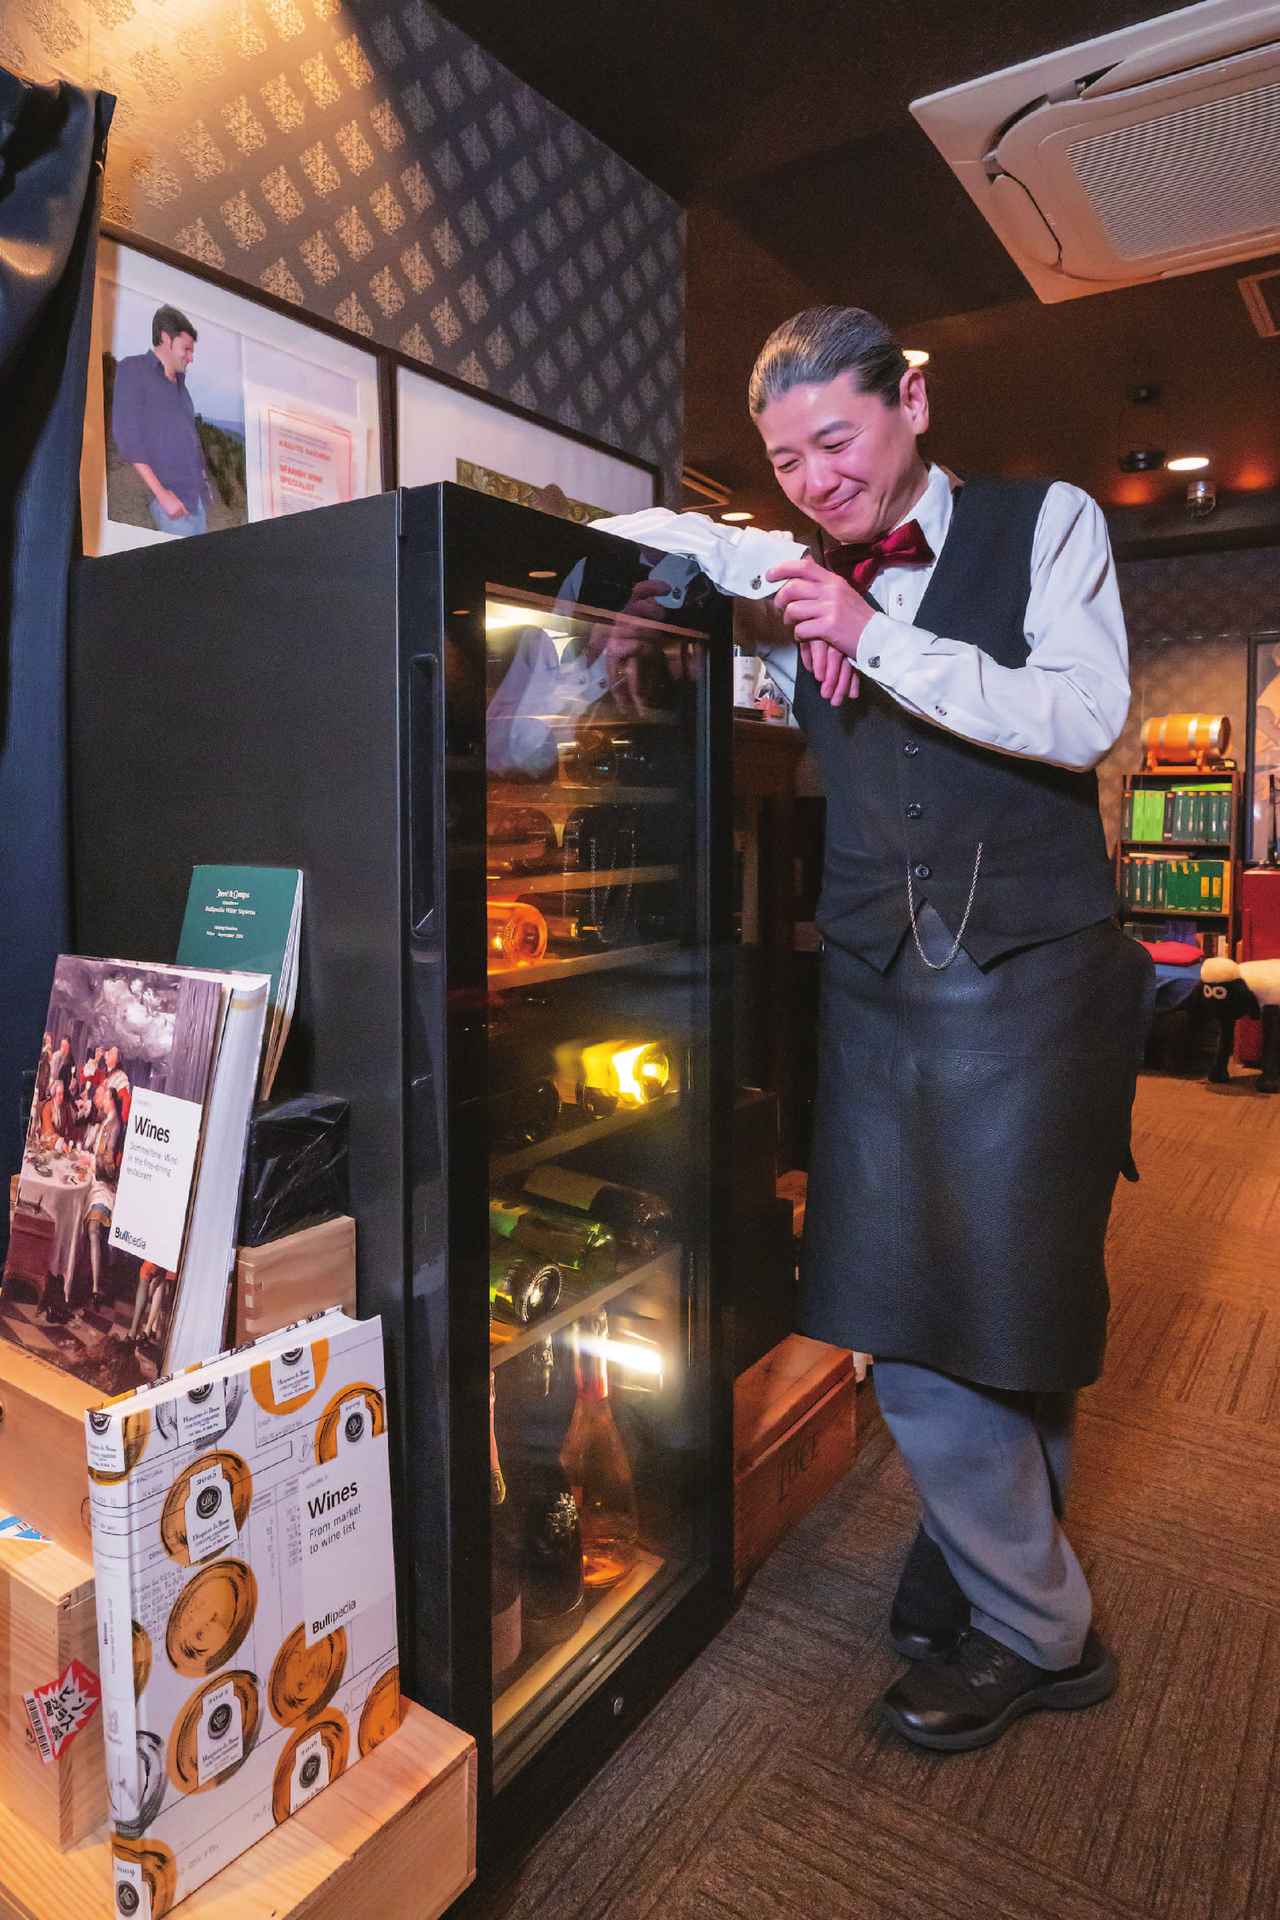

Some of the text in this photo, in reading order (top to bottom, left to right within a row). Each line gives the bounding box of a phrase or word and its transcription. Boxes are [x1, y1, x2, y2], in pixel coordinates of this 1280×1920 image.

[134, 1115, 170, 1143] Wines
[307, 1482, 358, 1519] Wines
[309, 1503, 361, 1541] From market
[310, 1521, 356, 1555] to wine list
[312, 1599, 356, 1634] Bullipedia
